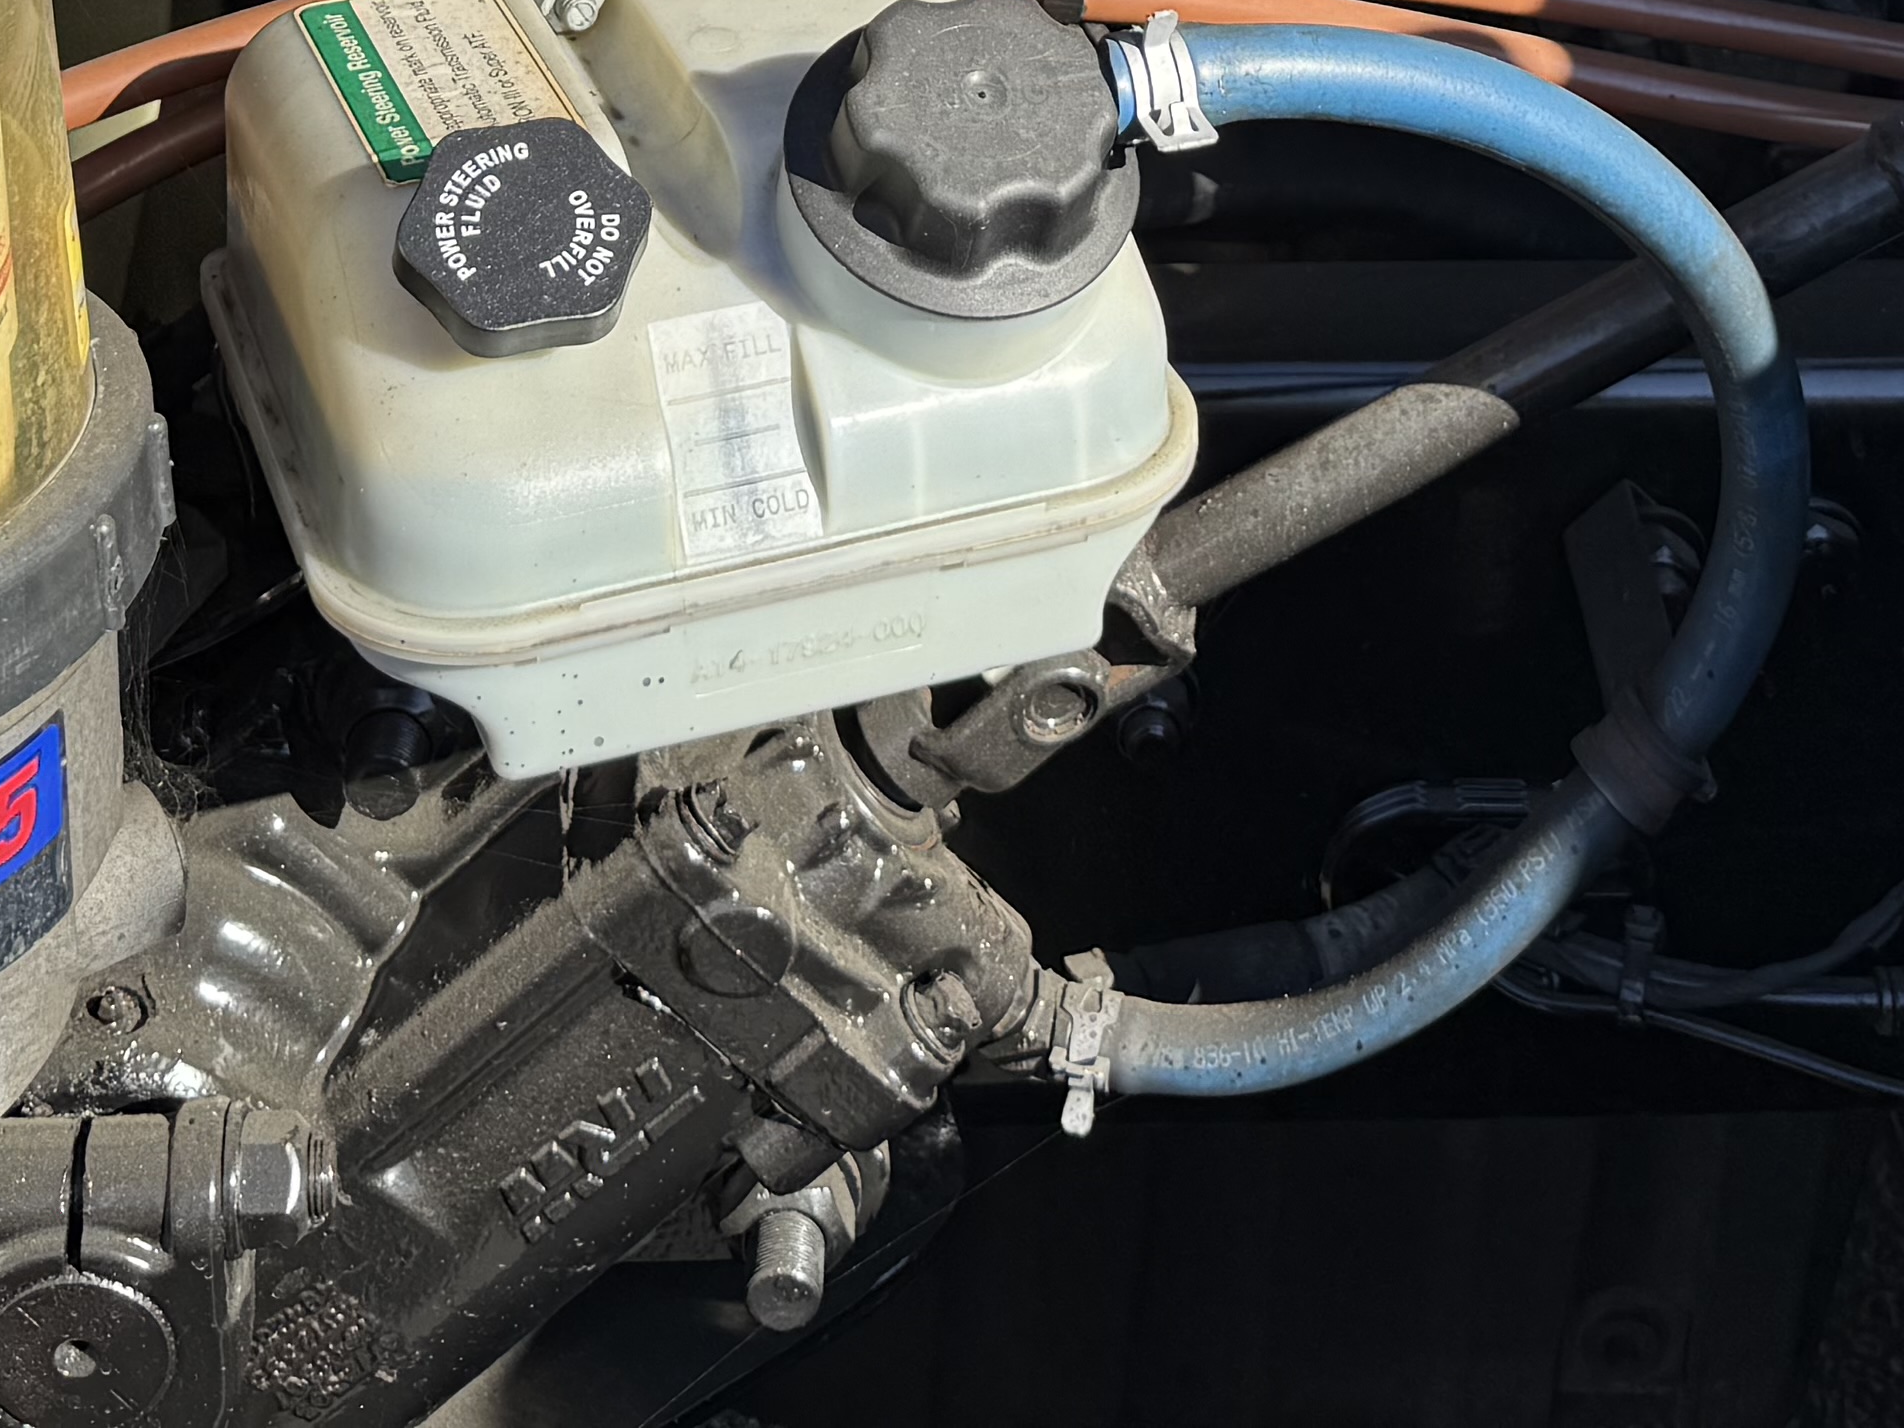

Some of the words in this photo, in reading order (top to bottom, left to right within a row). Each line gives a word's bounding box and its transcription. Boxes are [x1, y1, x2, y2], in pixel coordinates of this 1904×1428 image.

[409, 0, 433, 24] Fluid
[324, 13, 371, 73] Reservoir
[393, 37, 411, 52] on
[401, 51, 420, 77] mark
[423, 21, 465, 84] Transmission
[358, 71, 402, 125] Steering
[388, 125, 425, 167] Power
[439, 141, 529, 207] STEERING
[461, 174, 502, 237] FLUID
[600, 213, 621, 242] DO
[436, 209, 478, 281] POWER
[539, 189, 596, 278] OVERFILL
[578, 245, 615, 286] NOT
[664, 344, 711, 375] MAX
[724, 333, 782, 363] FILL
[692, 502, 737, 532] MIN
[752, 487, 810, 519] COLD
